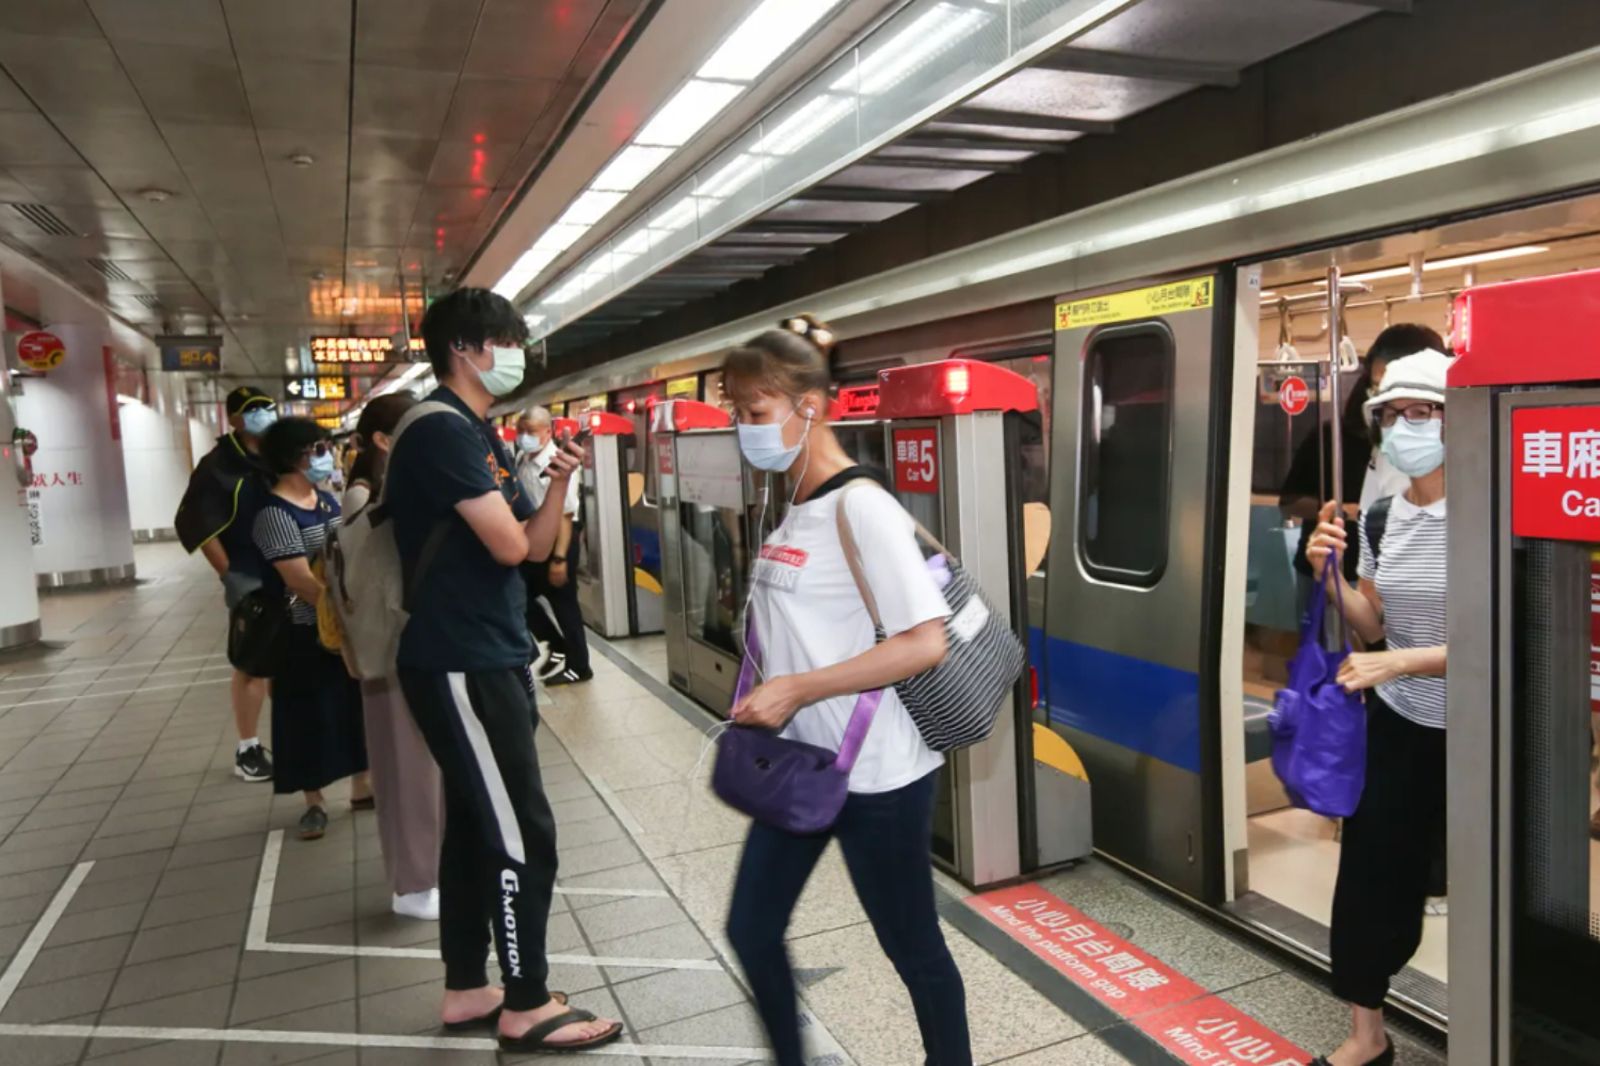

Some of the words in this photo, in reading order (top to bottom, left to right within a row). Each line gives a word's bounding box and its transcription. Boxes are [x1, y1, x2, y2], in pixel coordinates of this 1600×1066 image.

[906, 468, 920, 481] Car
[920, 440, 935, 482] 5
[1522, 428, 1600, 478] 車廂
[501, 868, 522, 978] G-MOTION
[1014, 899, 1169, 991] 小心月台間隙
[990, 905, 1026, 926] Mind
[1018, 925, 1043, 940] the
[1035, 940, 1098, 978] platform
[1089, 978, 1128, 998] gap
[1164, 1027, 1221, 1060] Mind
[1195, 1018, 1302, 1066] 小心
